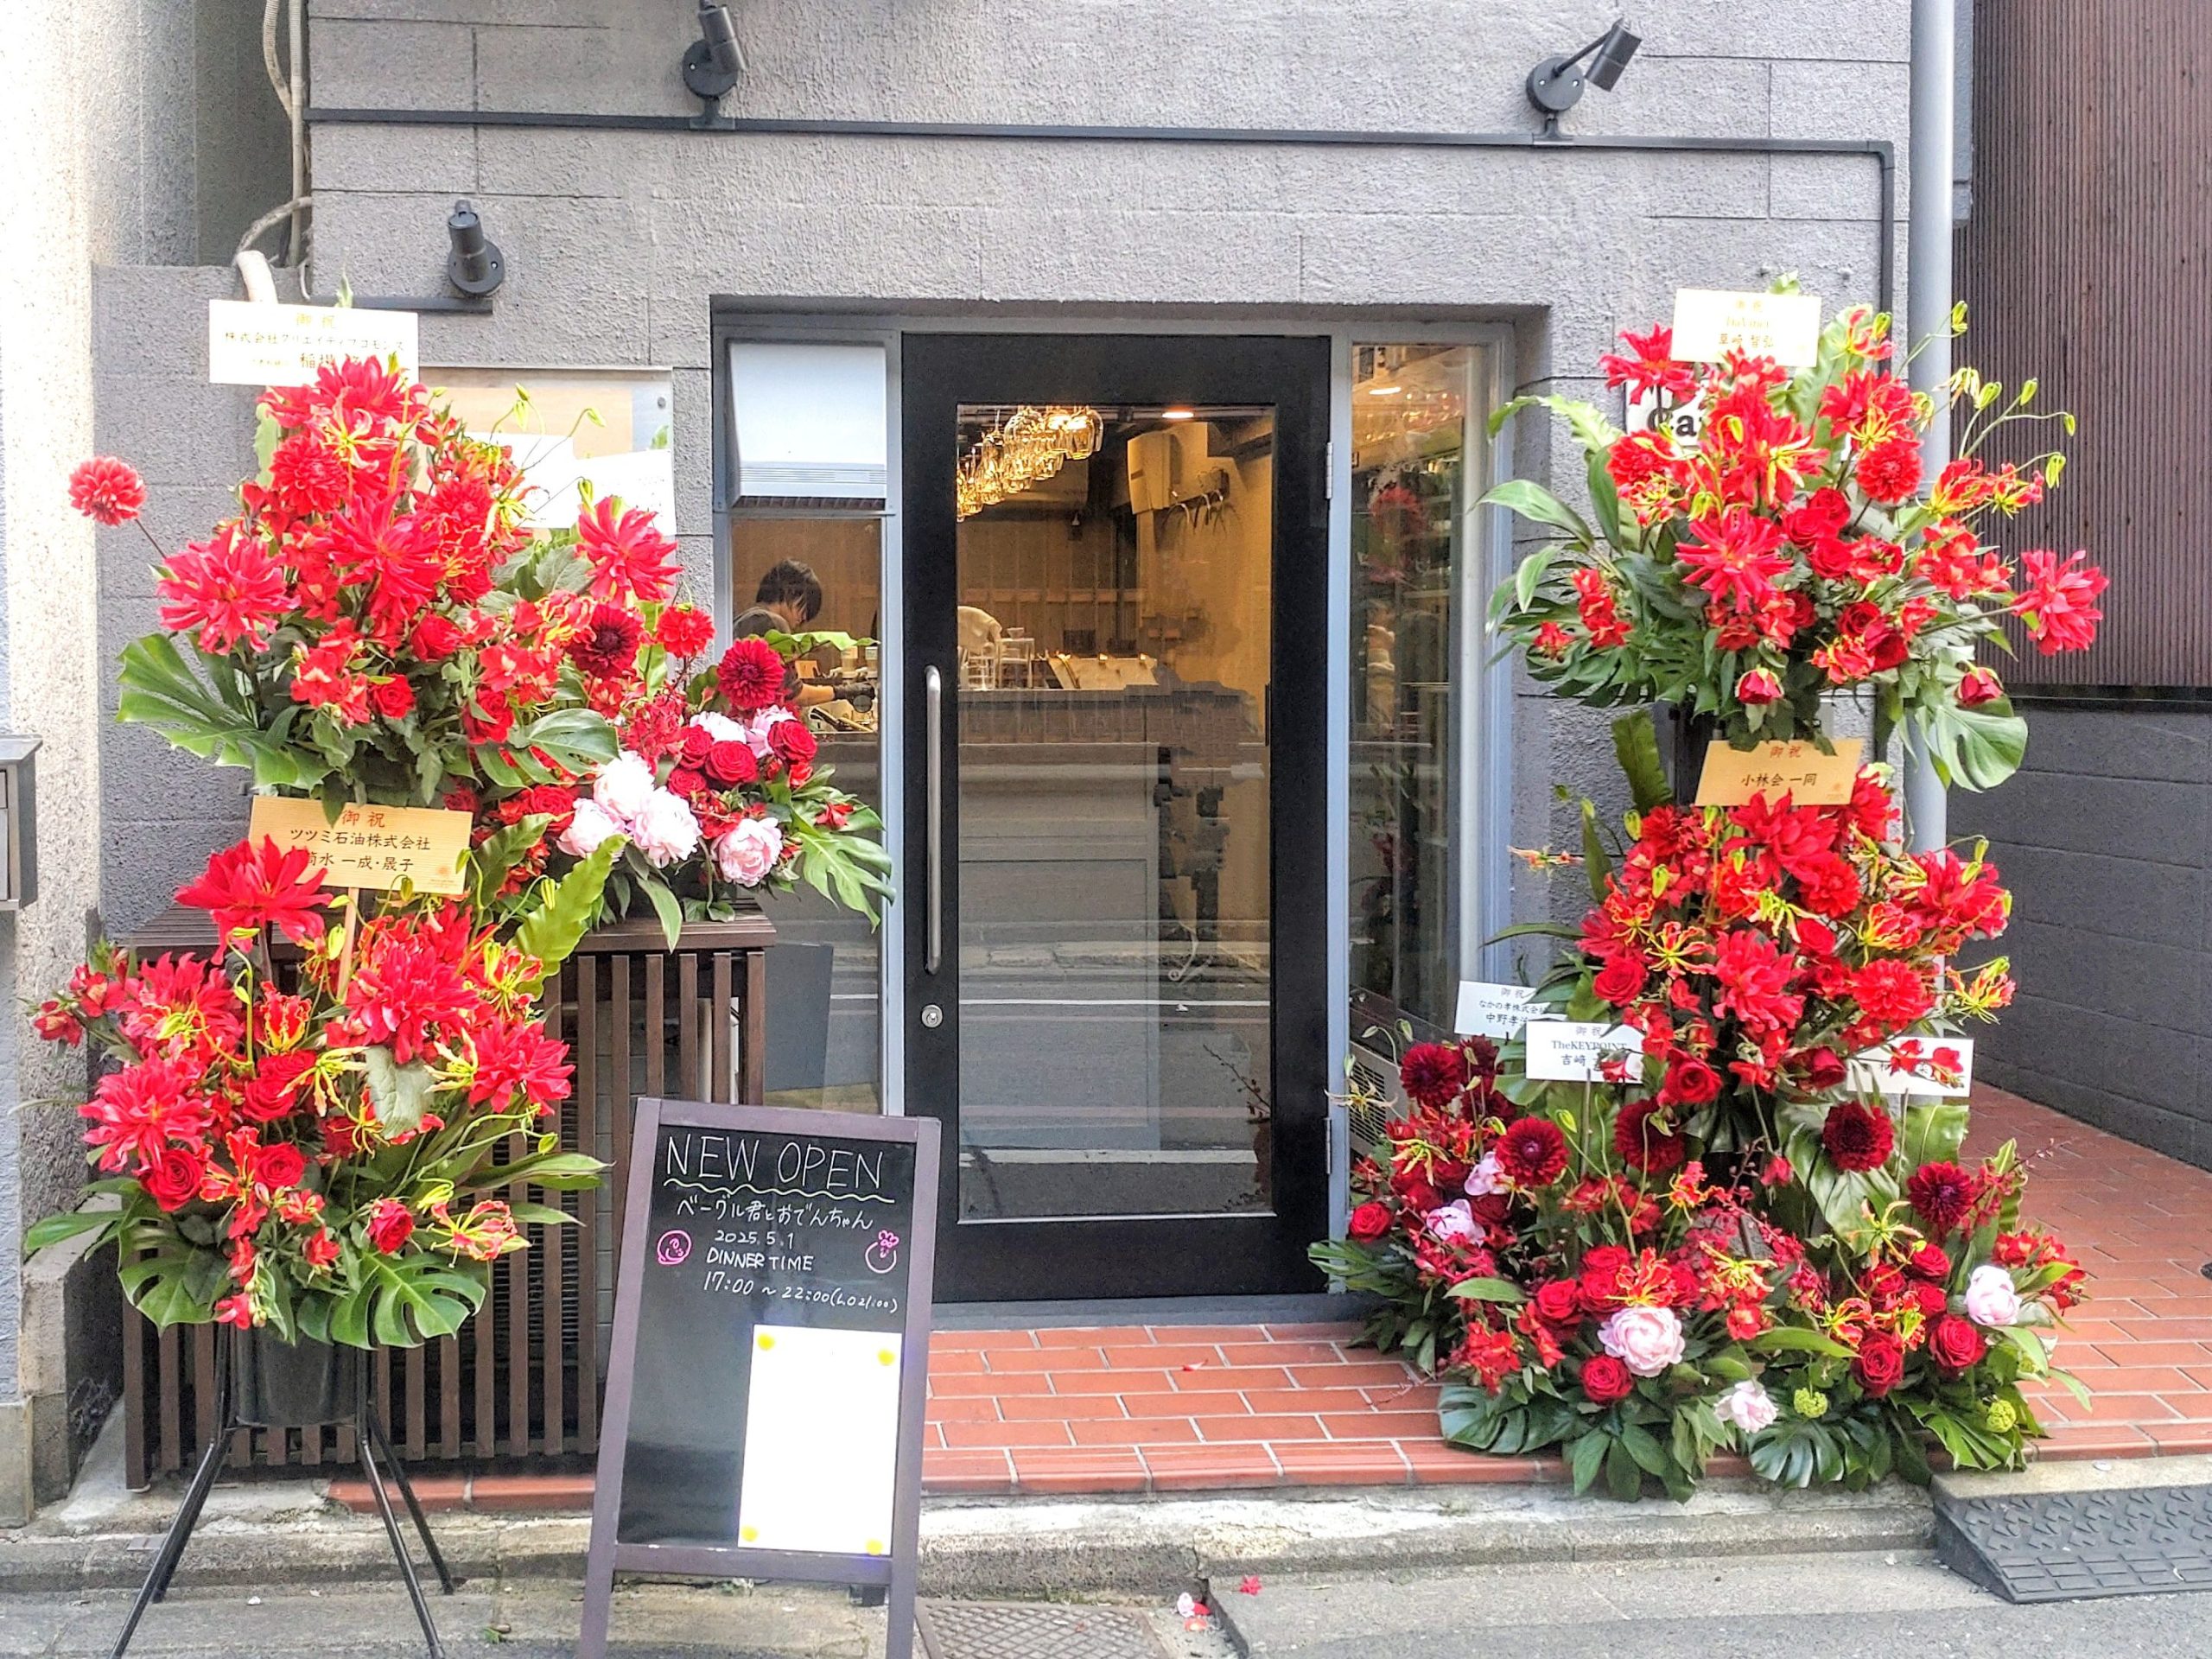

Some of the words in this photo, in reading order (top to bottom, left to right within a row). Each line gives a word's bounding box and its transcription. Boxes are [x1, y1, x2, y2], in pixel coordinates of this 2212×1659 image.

[1769, 746, 1802, 758] 御祝
[342, 810, 386, 829] 御祝
[290, 829, 431, 851] ツツミ石油株式会社
[1500, 988, 1525, 999] 御祝
[1576, 1026, 1602, 1037] 御祝
[666, 1133, 760, 1182] NEW
[777, 1141, 883, 1190] OPEN
[677, 1194, 874, 1230] ベーグル君とおでんちゃん
[706, 1247, 766, 1269] DINNER
[768, 1254, 815, 1272] TIME
[702, 1271, 754, 1295] 17:00
